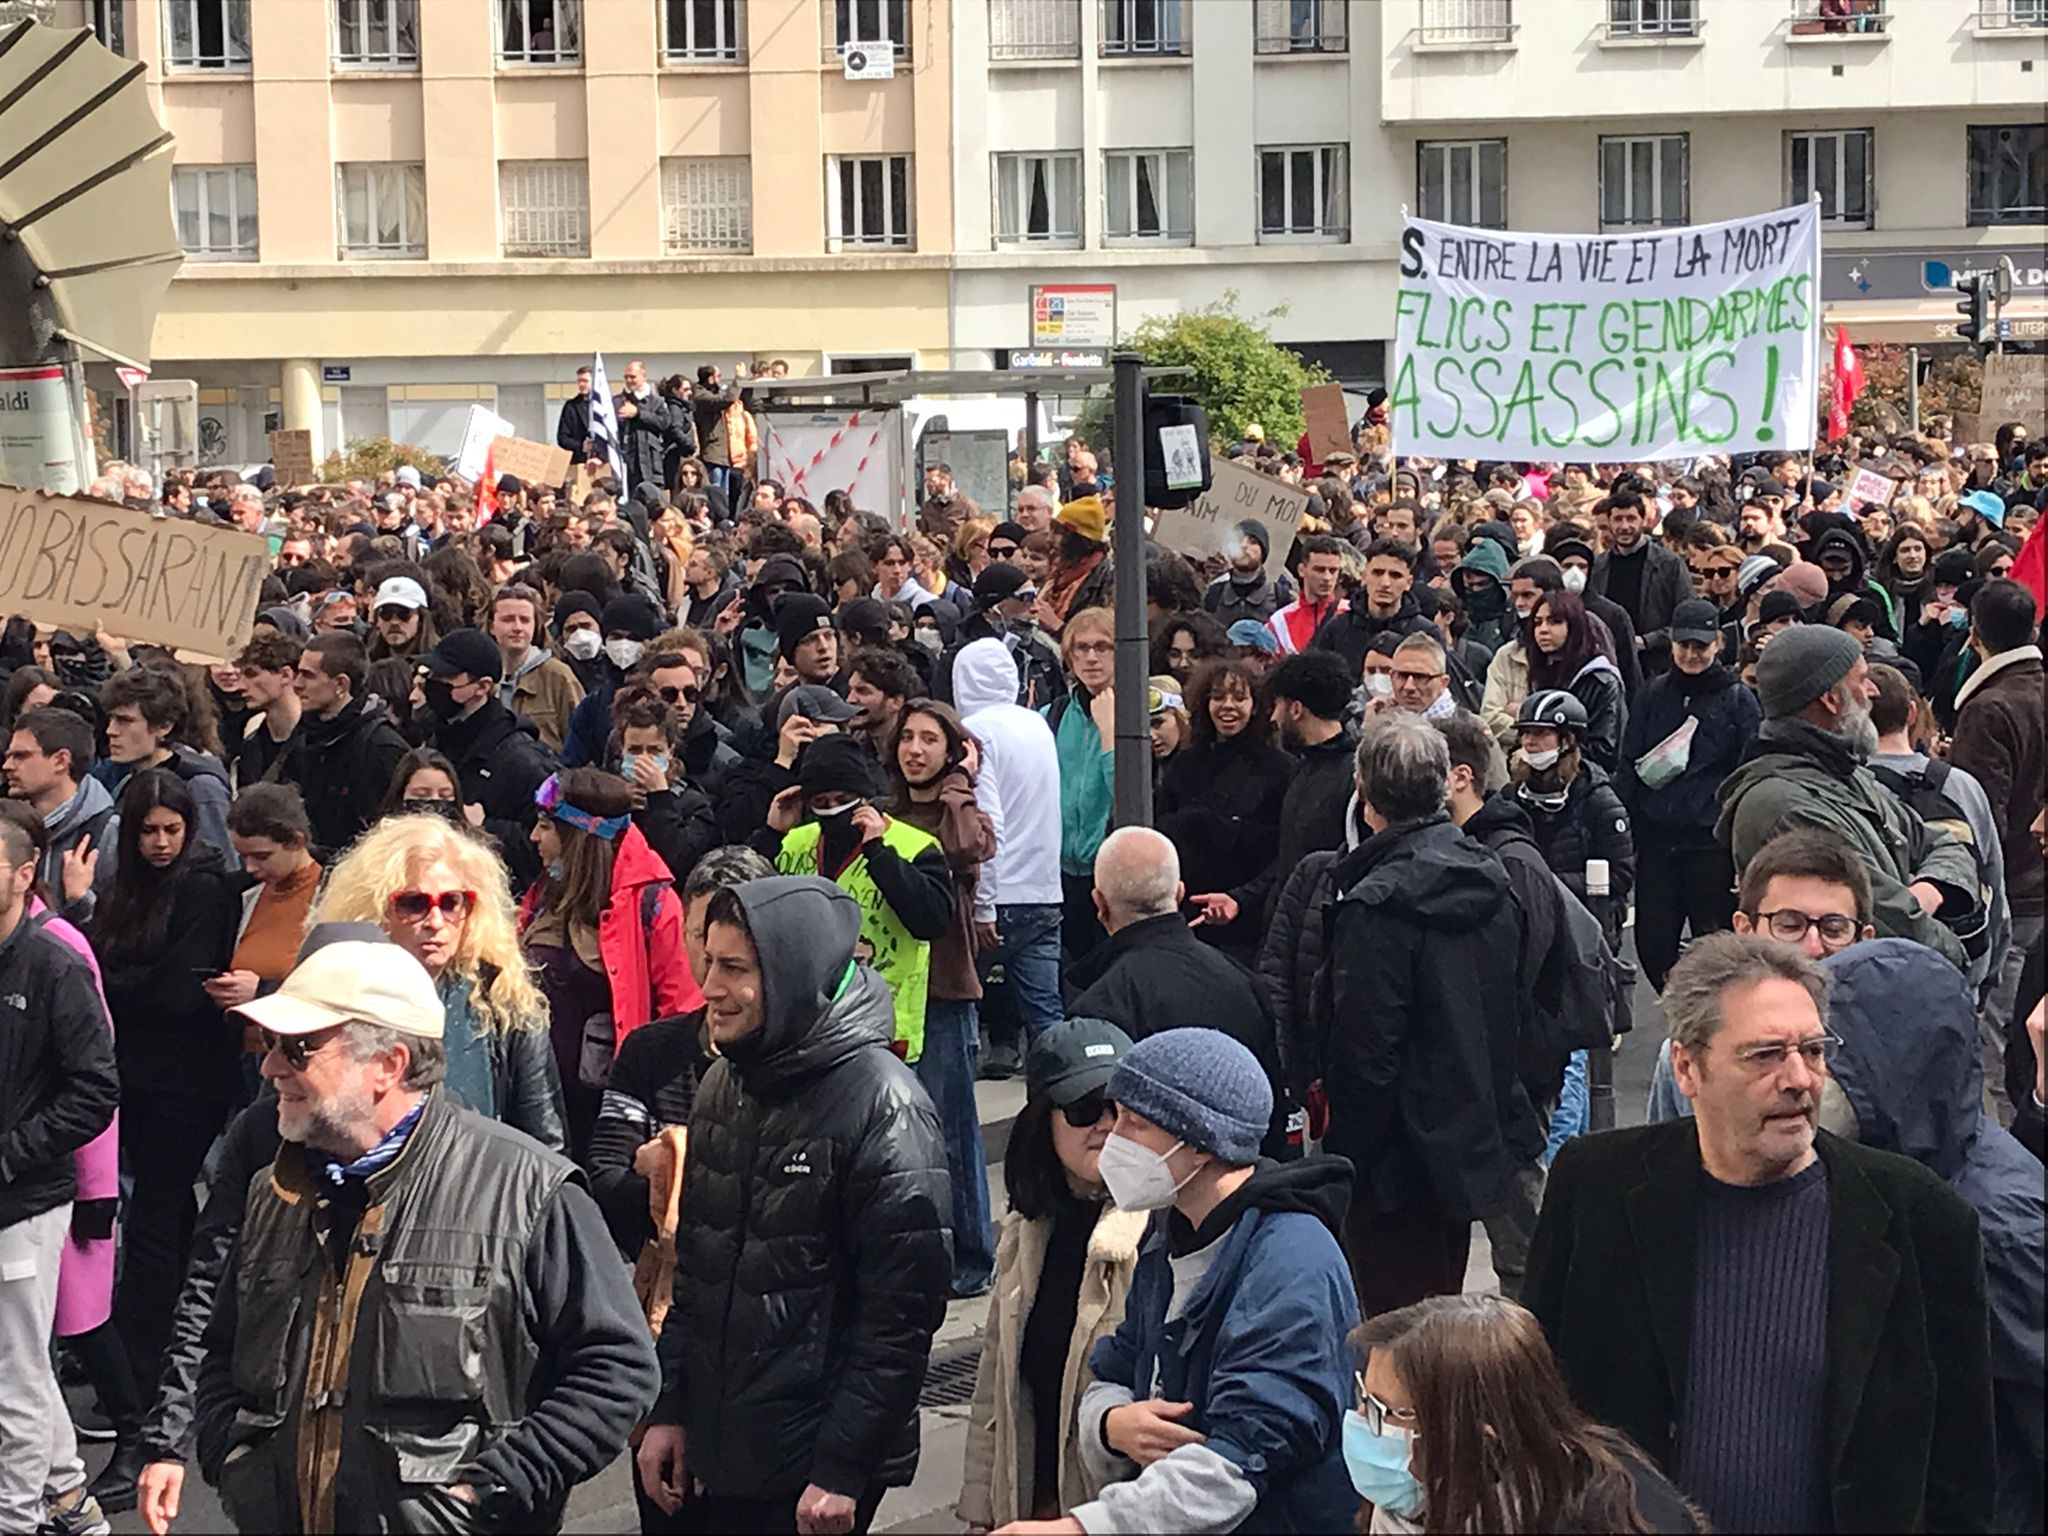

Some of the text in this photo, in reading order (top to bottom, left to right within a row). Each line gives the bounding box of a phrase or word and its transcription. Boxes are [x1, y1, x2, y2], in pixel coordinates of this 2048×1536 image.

[1438, 237, 1517, 280] ENTRE
[1527, 238, 1563, 283] LA
[1625, 237, 1662, 285] ET
[1673, 235, 1712, 279] LA
[1720, 217, 1801, 276] MORT
[1396, 273, 1813, 355] FLICS ET GENDARMES
[1234, 481, 1260, 508] DU
